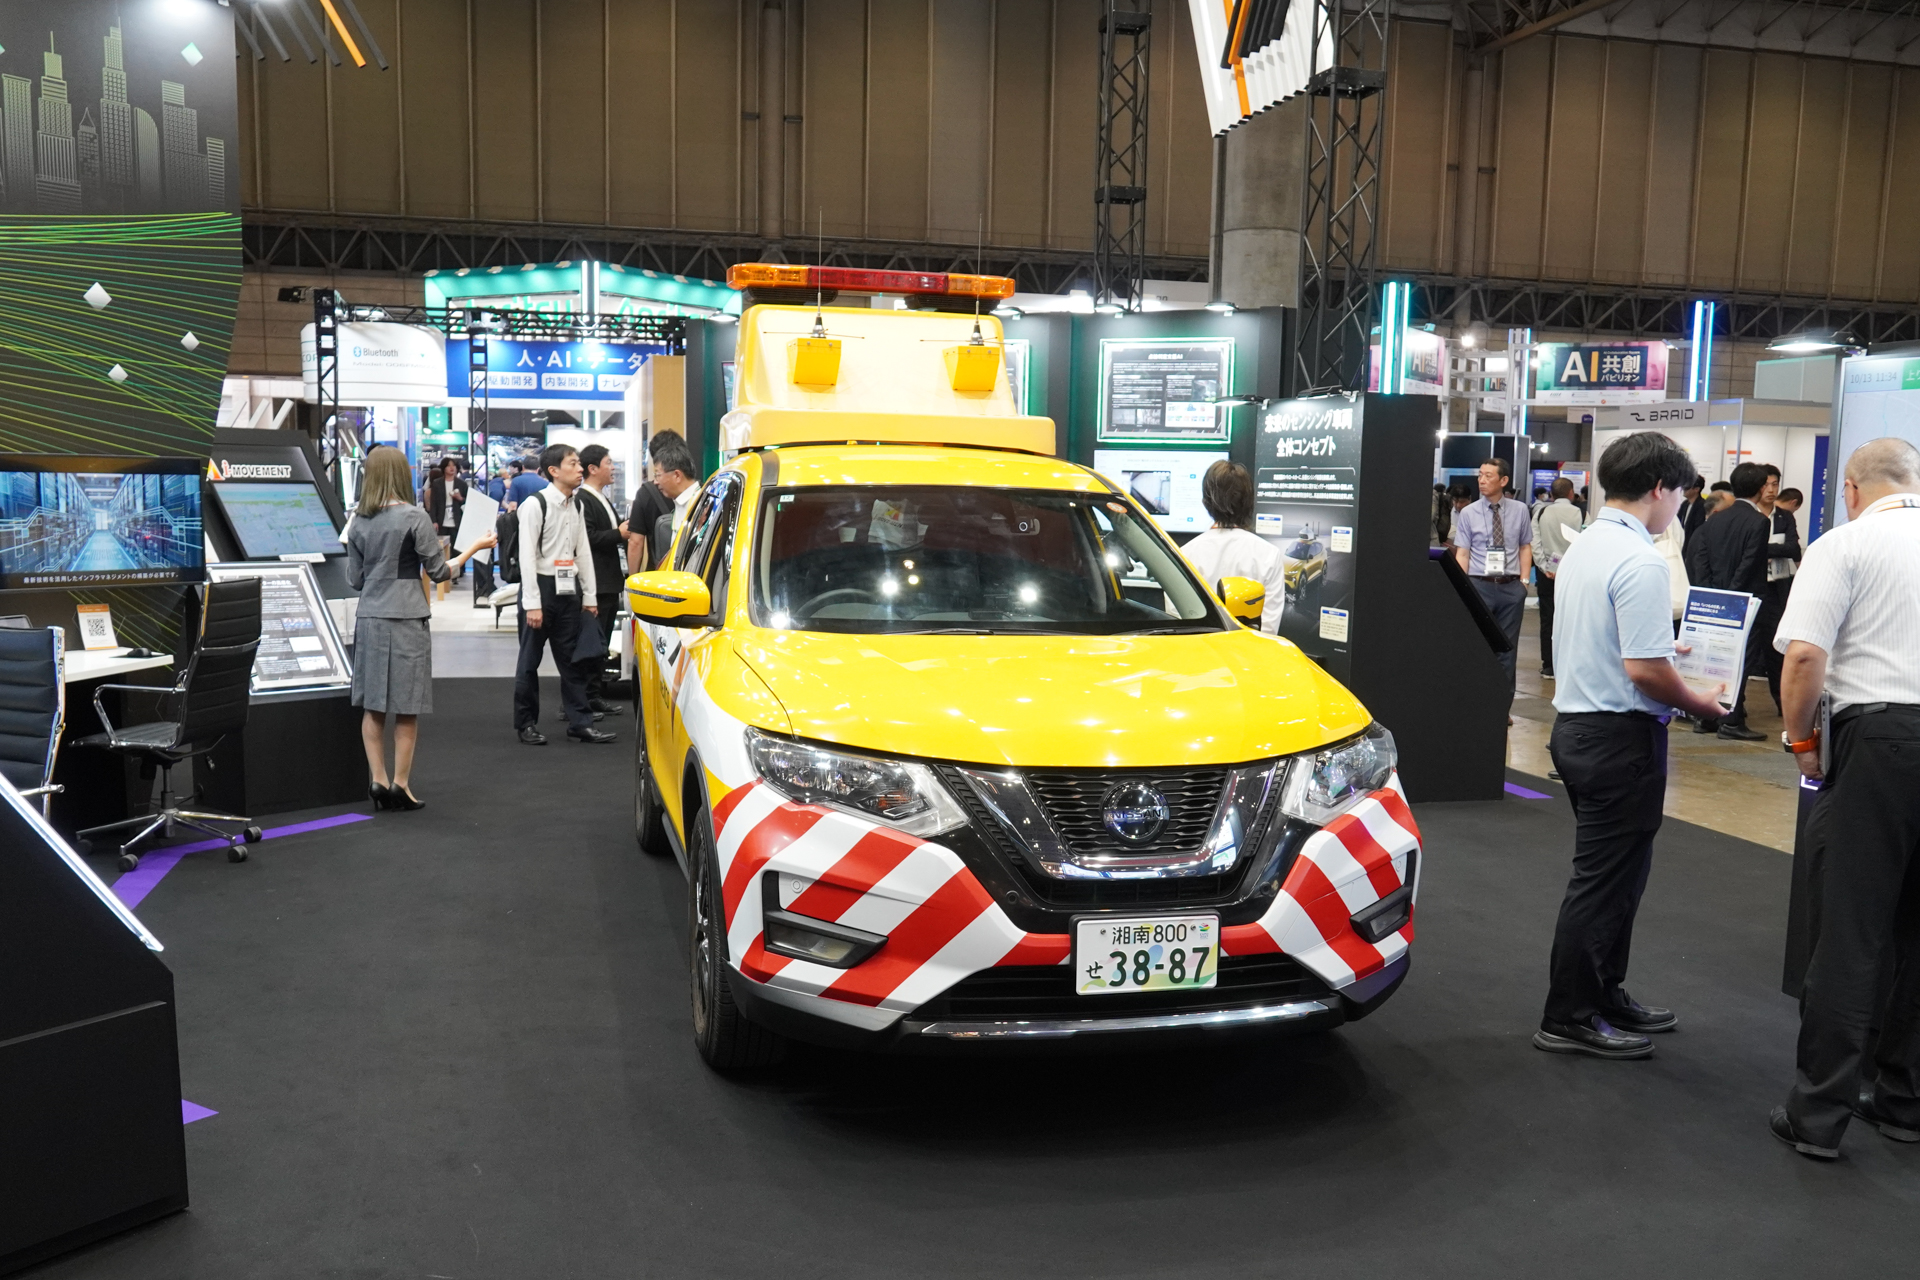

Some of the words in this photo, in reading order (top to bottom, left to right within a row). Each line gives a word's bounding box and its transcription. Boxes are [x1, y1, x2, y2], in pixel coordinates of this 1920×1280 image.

[363, 347, 399, 357] Bluetooth
[516, 349, 659, 370] 人・AI・データ
[1560, 351, 1599, 383] AI
[1602, 355, 1641, 374] 共創
[473, 374, 533, 387] A駆動開発
[545, 376, 590, 388] 内製開発
[1600, 373, 1640, 382] パビリオン
[1850, 373, 1872, 384] 10/13
[1875, 371, 1898, 382] 11:34
[1264, 407, 1354, 433] 未来のセンシング車両
[1649, 408, 1695, 421] BRAID
[1276, 434, 1337, 457] 全体コンセプト
[222, 460, 291, 478] i-MOVEMENT
[1112, 809, 1162, 819] NISSAN
[1112, 925, 1151, 945] 湘南
[1153, 923, 1187, 943] 800
[1085, 960, 1103, 979] せ
[1108, 946, 1210, 987] 38-87
